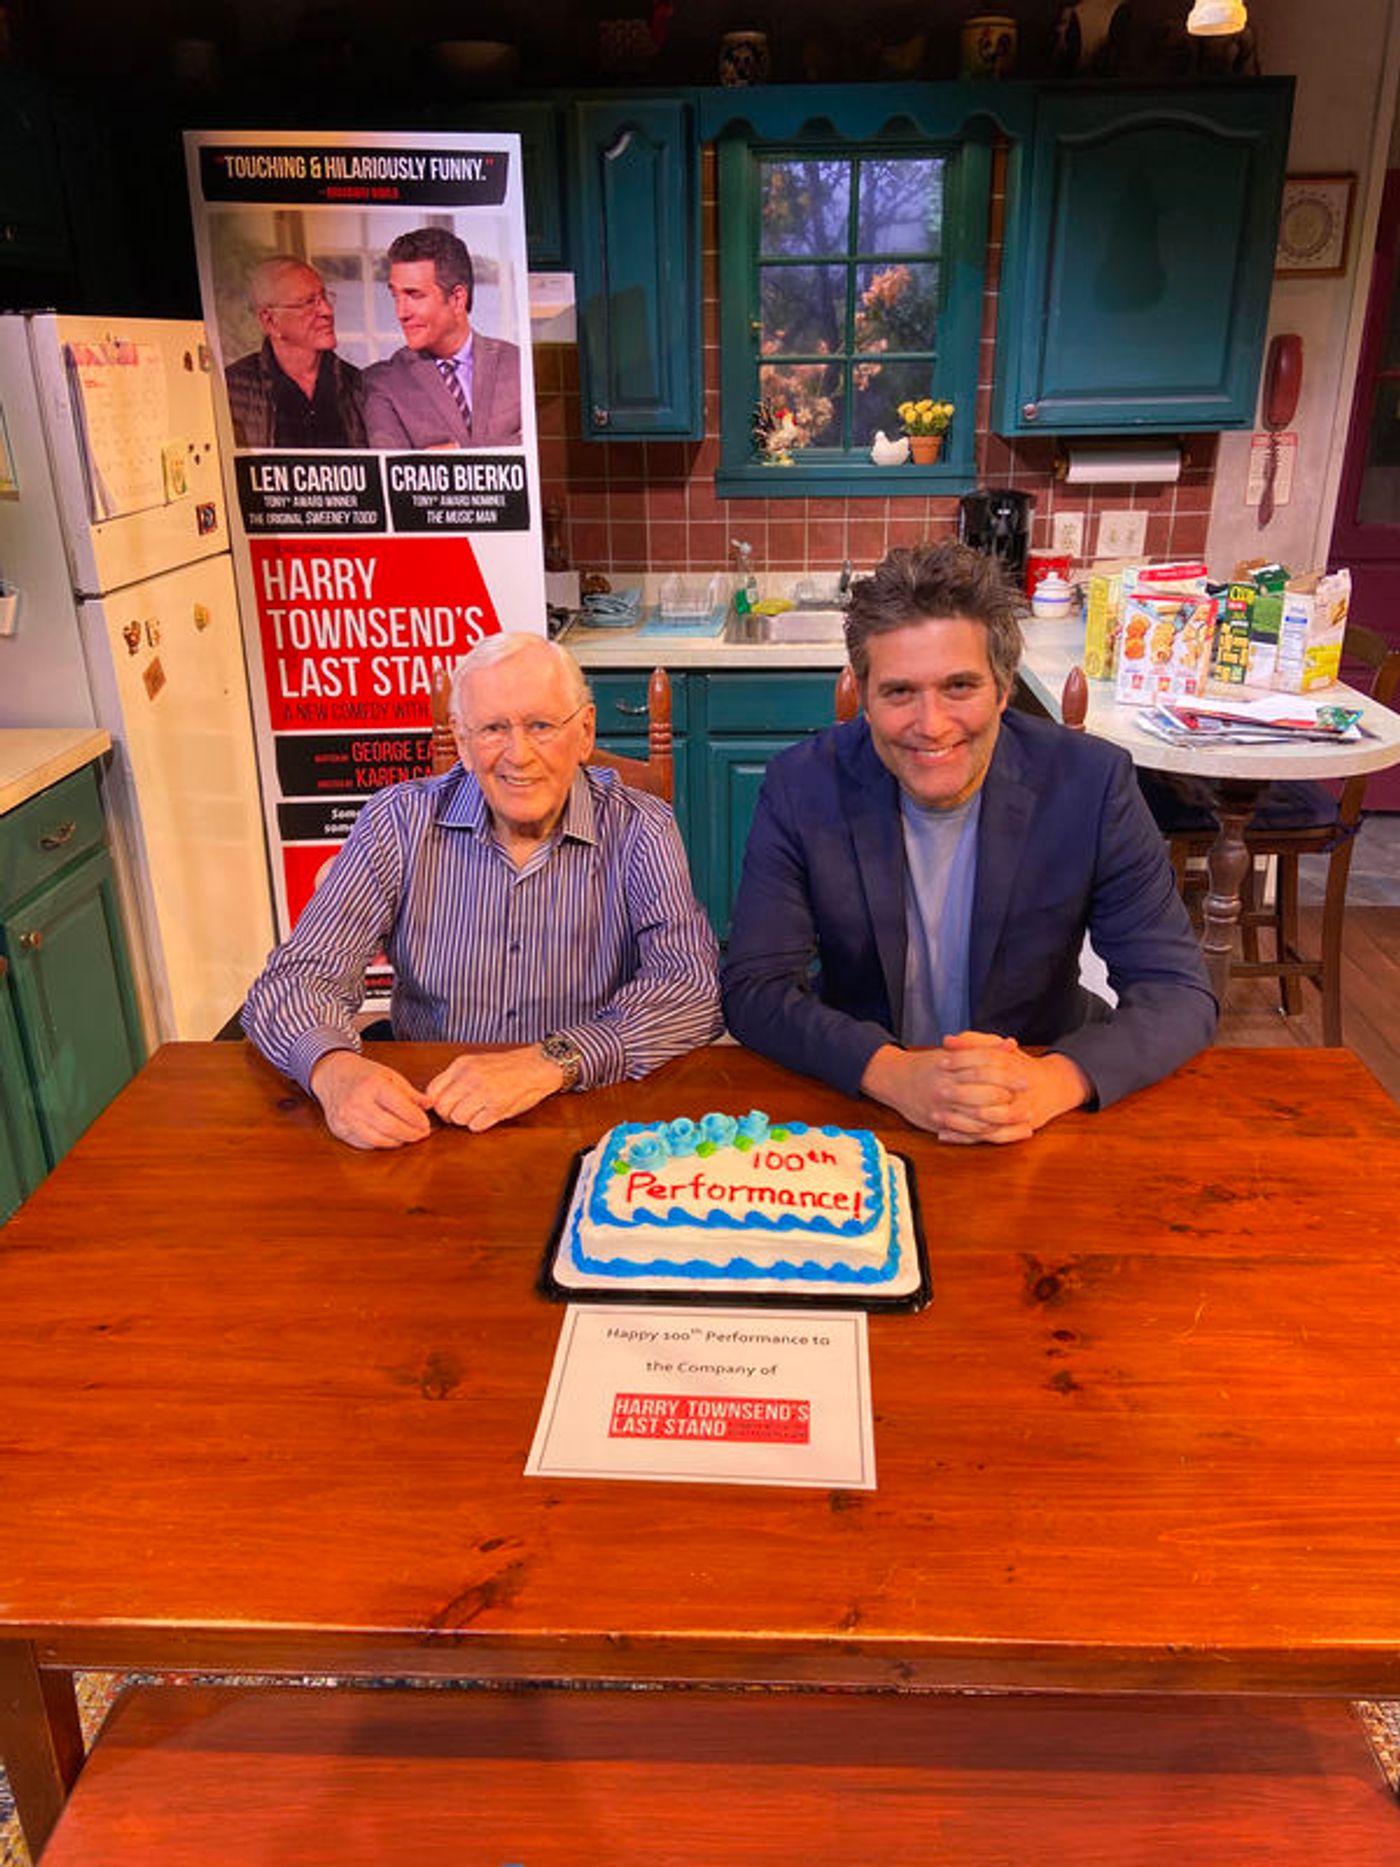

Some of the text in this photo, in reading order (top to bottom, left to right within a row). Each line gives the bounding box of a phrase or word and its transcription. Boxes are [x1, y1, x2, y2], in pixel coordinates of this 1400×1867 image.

[310, 156, 323, 179] &
[324, 156, 426, 181] HILARIOUSLY
[250, 465, 366, 492] LEN CARIOU
[391, 464, 524, 492] CRAIG BIERKO
[324, 495, 358, 508] WINNER
[305, 511, 351, 525] SWEENEY
[352, 511, 378, 524] TODD
[427, 510, 498, 524] THE MUSIC MAN
[262, 557, 377, 601] HARRY
[266, 606, 485, 651] TOWNSEND'S
[277, 654, 468, 698] LAST STAN
[295, 702, 329, 721] NEW
[332, 701, 388, 721] COMEDY
[352, 741, 413, 763] GEORGE
[355, 765, 411, 788] KAREN
[752, 1150, 837, 1172] 100th
[626, 1171, 862, 1219] Performance!
[606, 1327, 830, 1346] Happy 100th Performance to
[646, 1361, 778, 1378] the Company of
[615, 1398, 810, 1422] HARRY TOWNSEND'S
[610, 1416, 658, 1434] LAST
[664, 1418, 727, 1438] STAND
